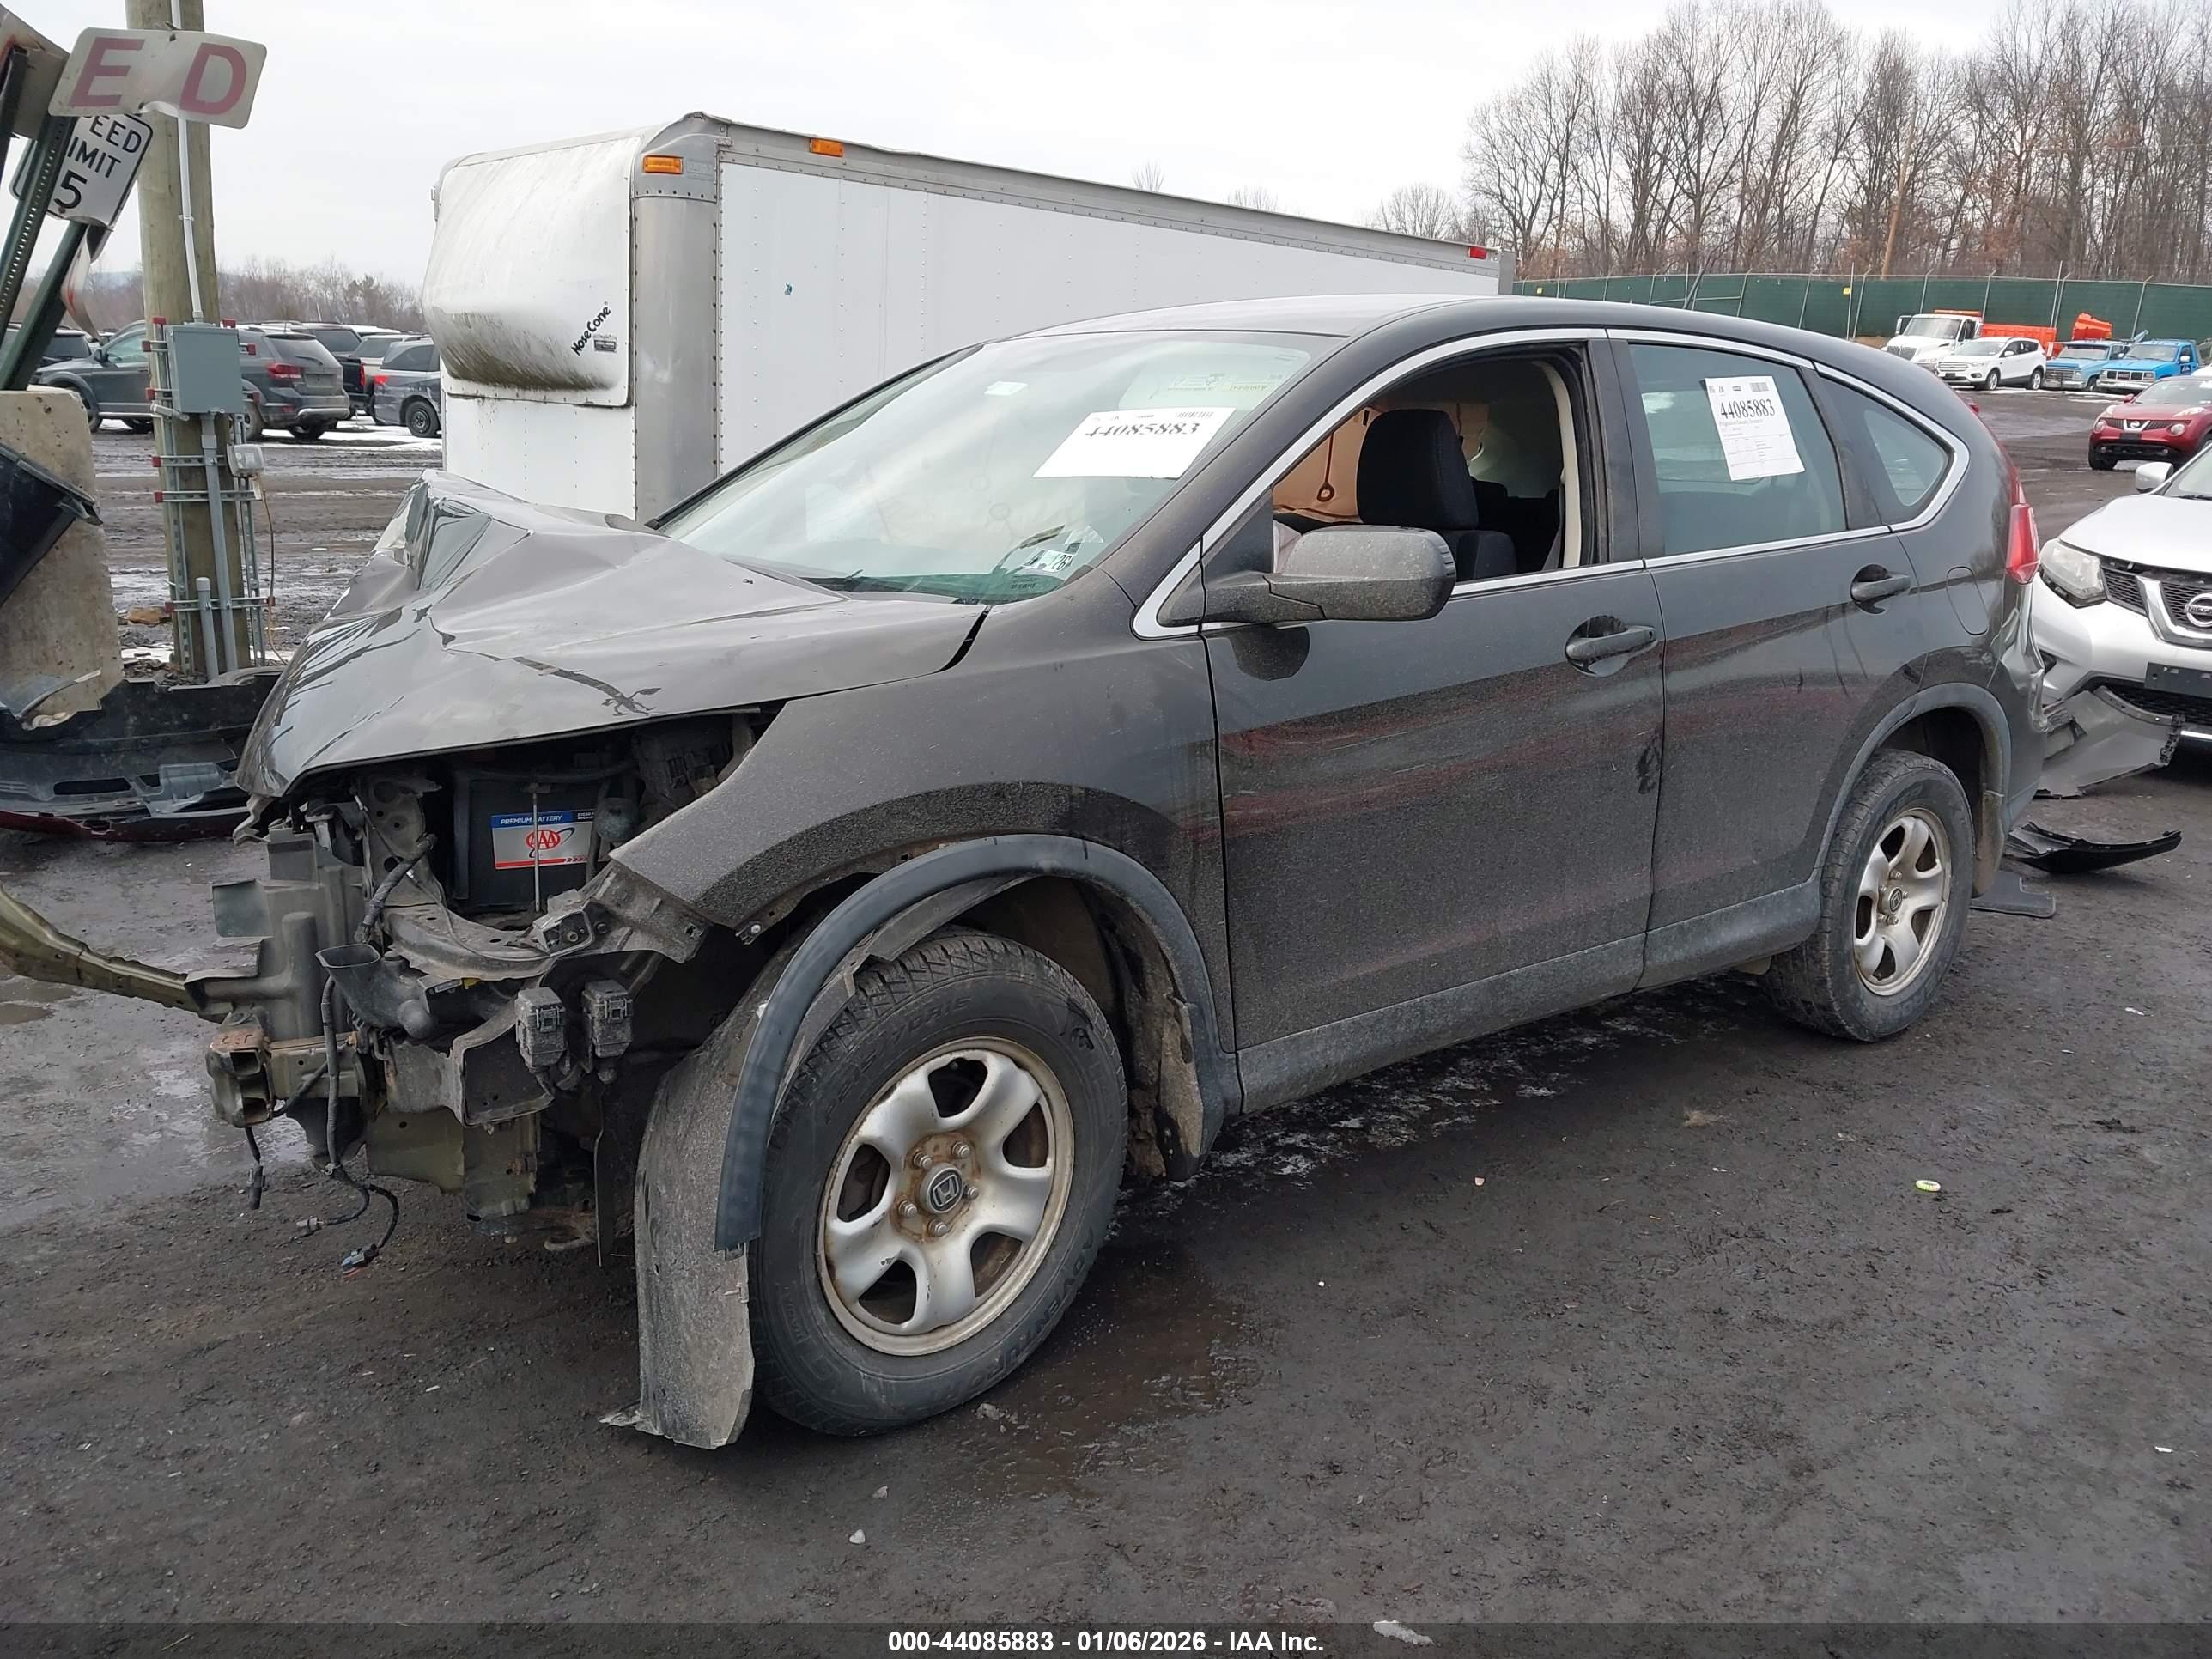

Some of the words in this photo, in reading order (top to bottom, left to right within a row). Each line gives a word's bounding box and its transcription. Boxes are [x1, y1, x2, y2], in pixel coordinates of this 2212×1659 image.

[69, 37, 145, 107] E
[179, 42, 246, 115] D
[88, 115, 142, 153] EED
[68, 137, 121, 178] IMIT
[1720, 398, 1775, 419] 44085883
[1085, 422, 1200, 437] 44085883
